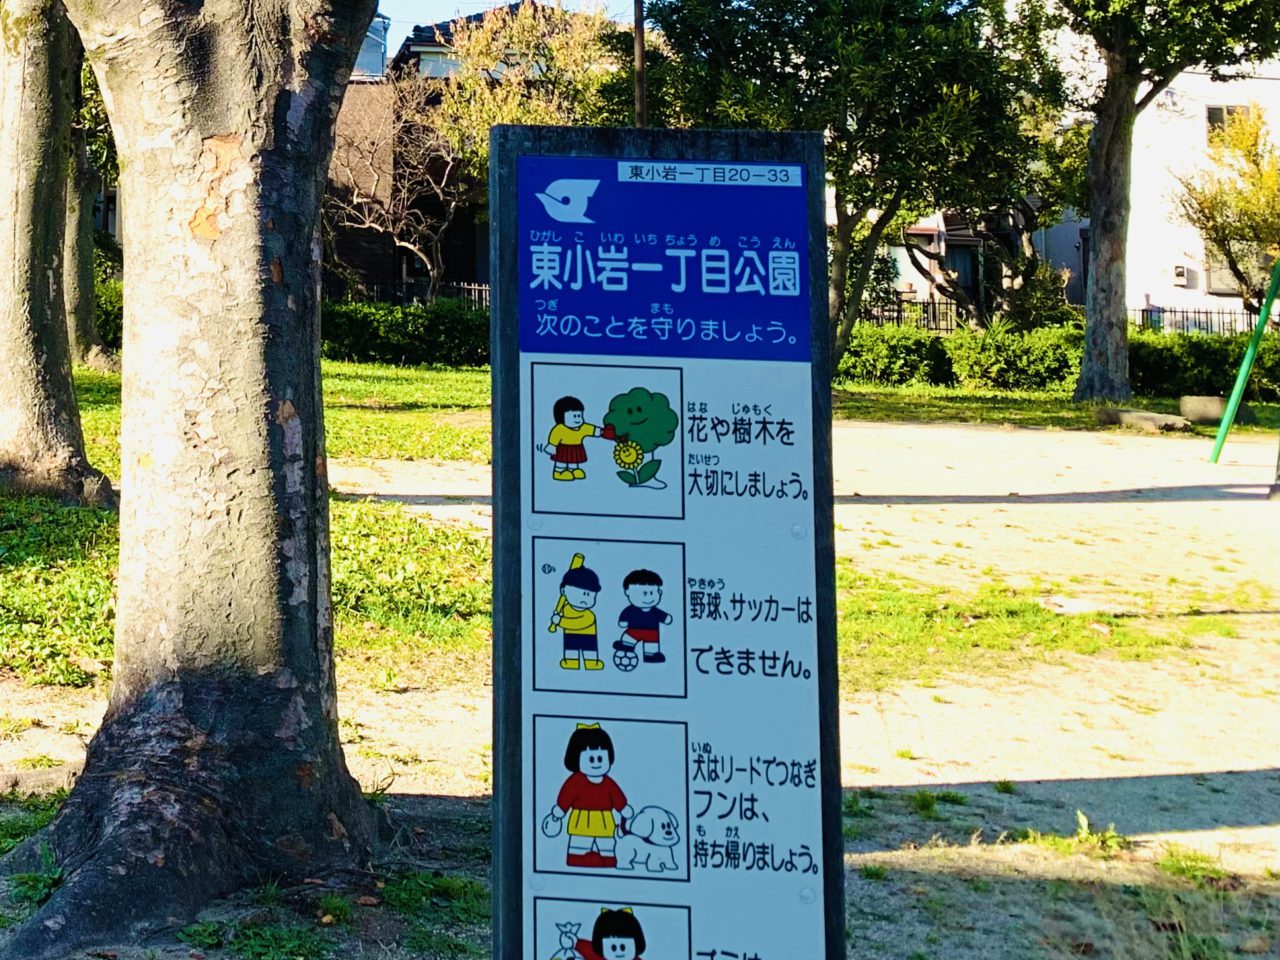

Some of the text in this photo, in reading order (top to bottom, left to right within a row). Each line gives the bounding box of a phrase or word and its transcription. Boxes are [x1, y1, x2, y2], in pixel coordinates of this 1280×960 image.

[628, 165, 790, 183] 東小岩一丁目20-33
[530, 230, 562, 242] ひがし
[600, 232, 624, 244] いわ
[634, 233, 658, 245] いち
[665, 234, 698, 246] ちょう
[709, 235, 721, 247] め
[738, 236, 761, 248] こう
[772, 237, 796, 249] えん
[529, 242, 801, 297] 東小岩一丁目公園
[535, 298, 674, 314] つぎ まも
[535, 313, 797, 345] 次のことを守りましょう。
[687, 401, 773, 416] はな じゅもく
[687, 414, 795, 446] 花や樹木を
[687, 452, 720, 466] たいせつ
[687, 468, 809, 501] 大切にしましょう。
[687, 577, 726, 591] やきゅう
[689, 591, 813, 624] 野球、サッカーは
[690, 644, 811, 680] できません。
[691, 741, 712, 754] いぬ
[693, 753, 817, 788] 犬はリードでつなぎ
[693, 790, 770, 823] フンは、
[696, 824, 741, 839] も かえ
[693, 838, 819, 875] 持ち帰りましょう。
